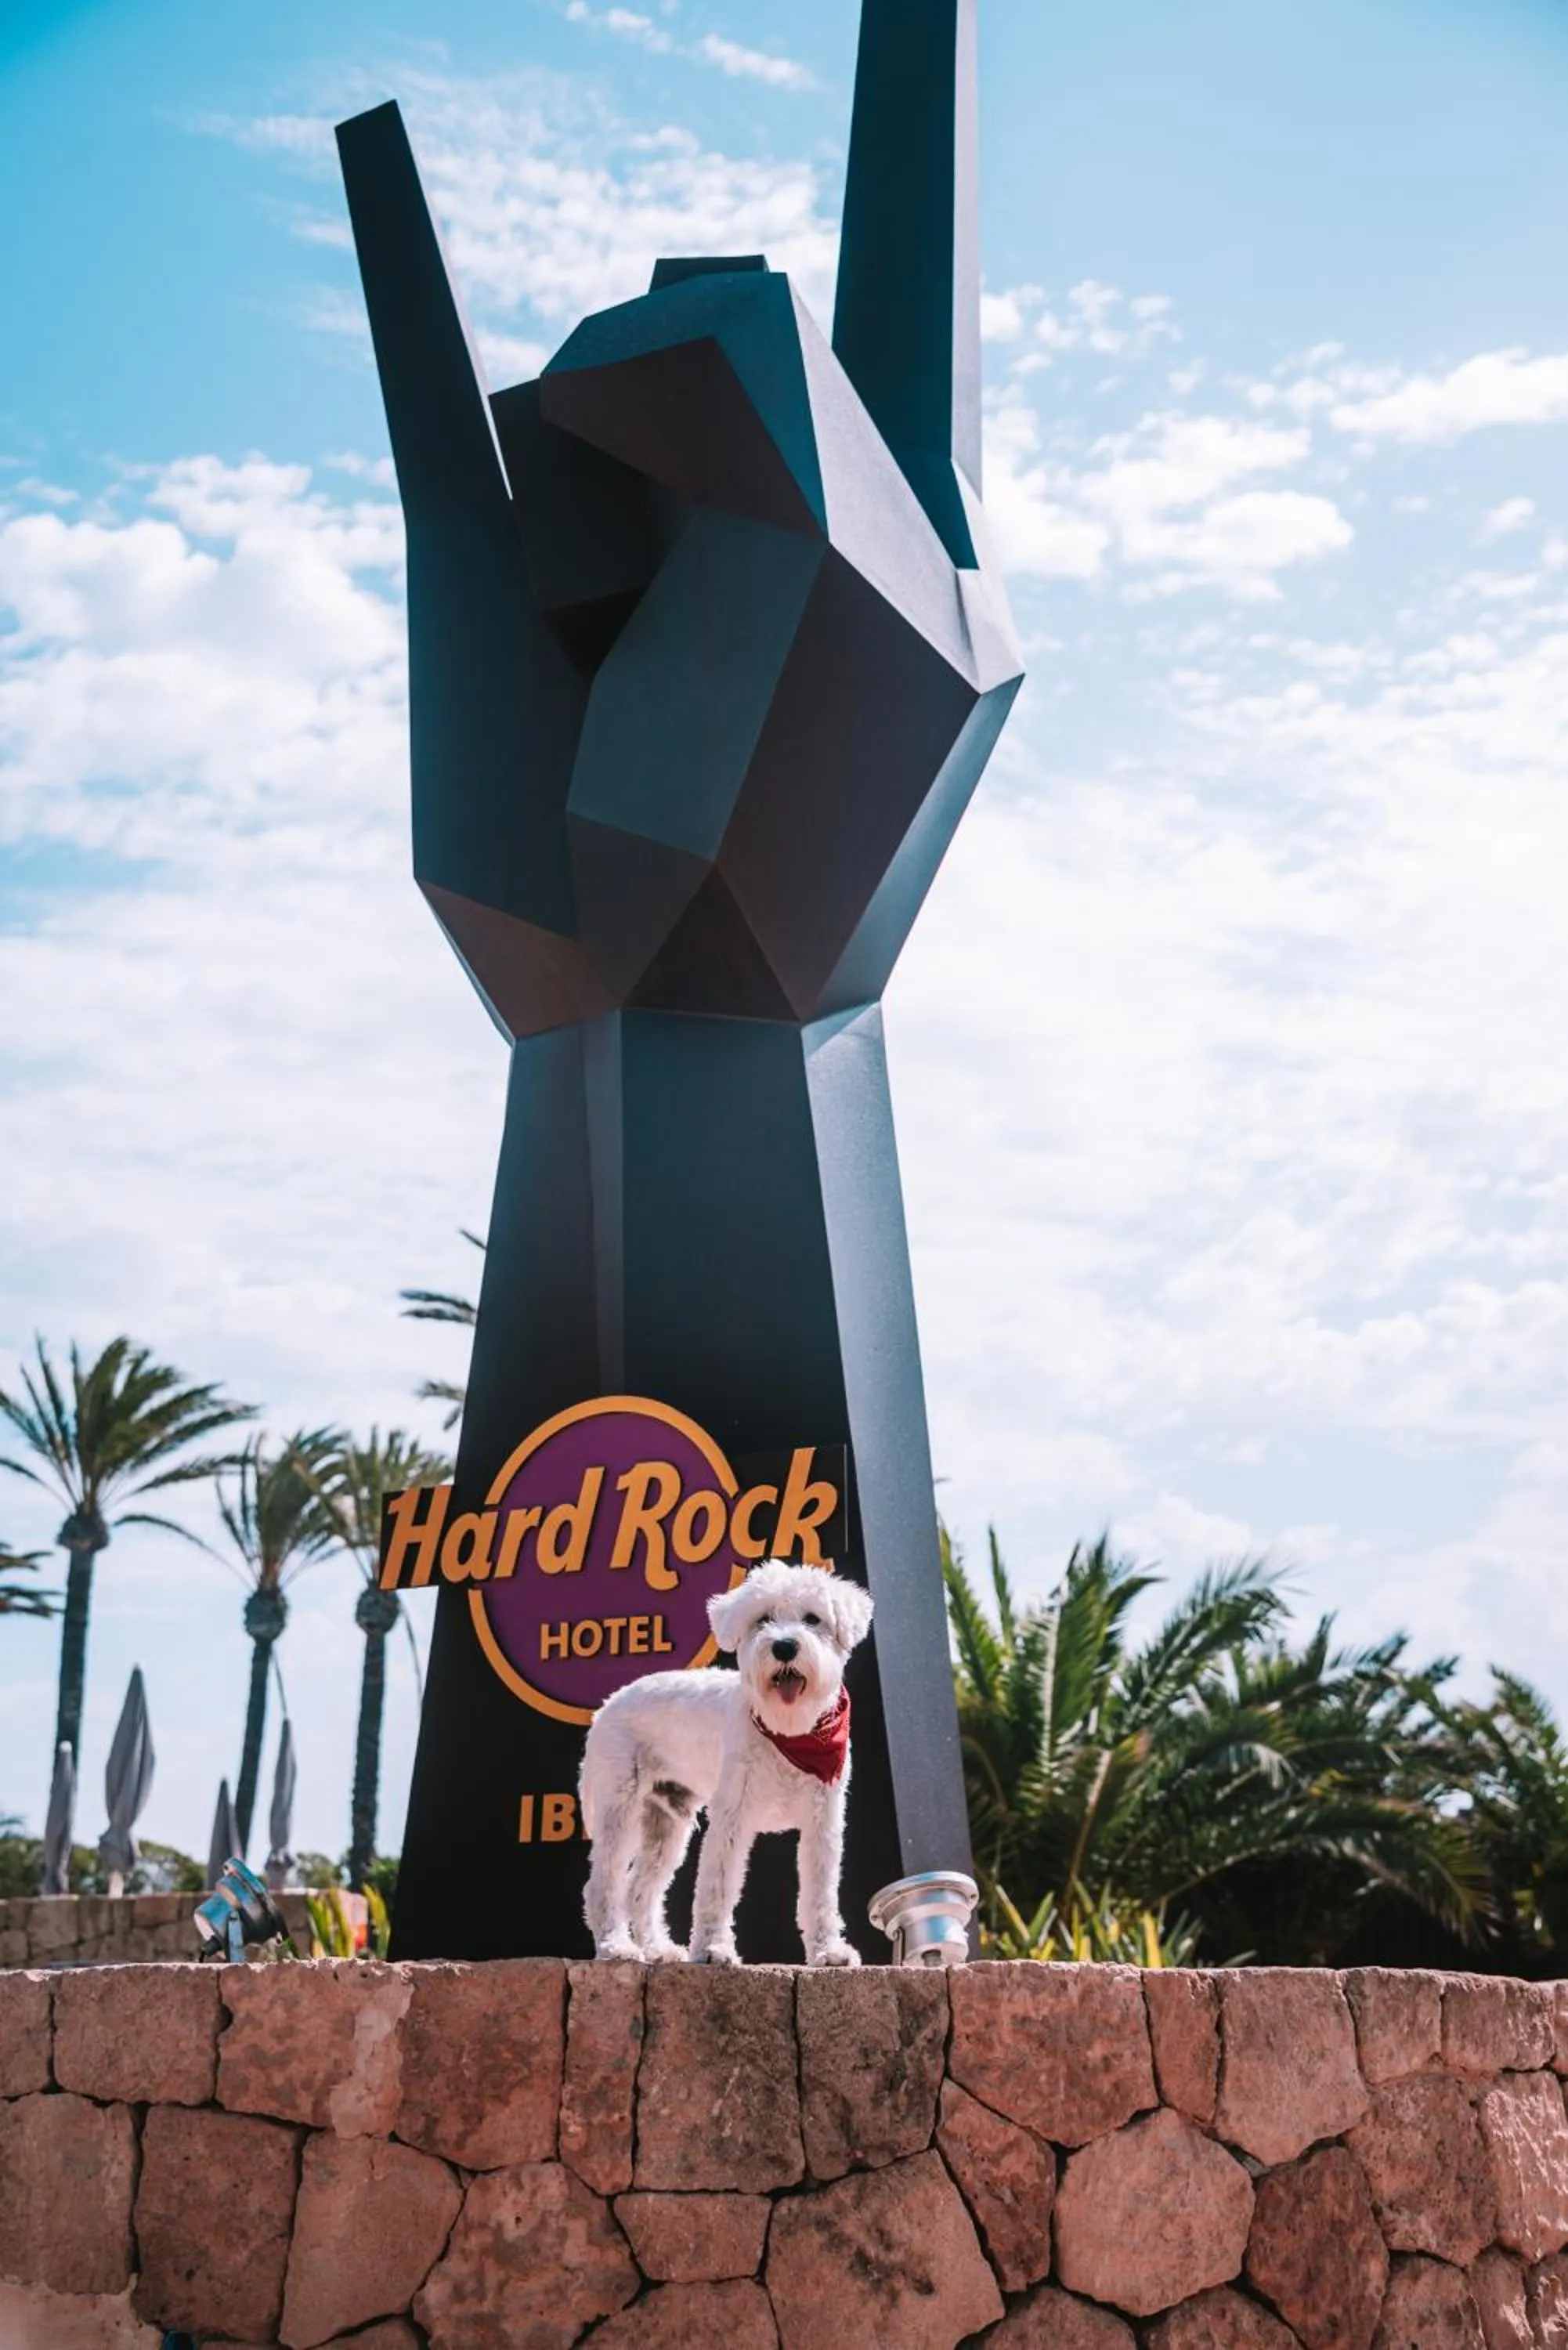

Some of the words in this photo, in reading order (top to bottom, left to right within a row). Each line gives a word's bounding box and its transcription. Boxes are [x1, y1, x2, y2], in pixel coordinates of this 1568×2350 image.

[380, 1466, 605, 1590] Hard
[609, 1446, 838, 1591] Rock
[540, 1614, 672, 1660] HOTEL
[519, 1793, 590, 1842] IB
